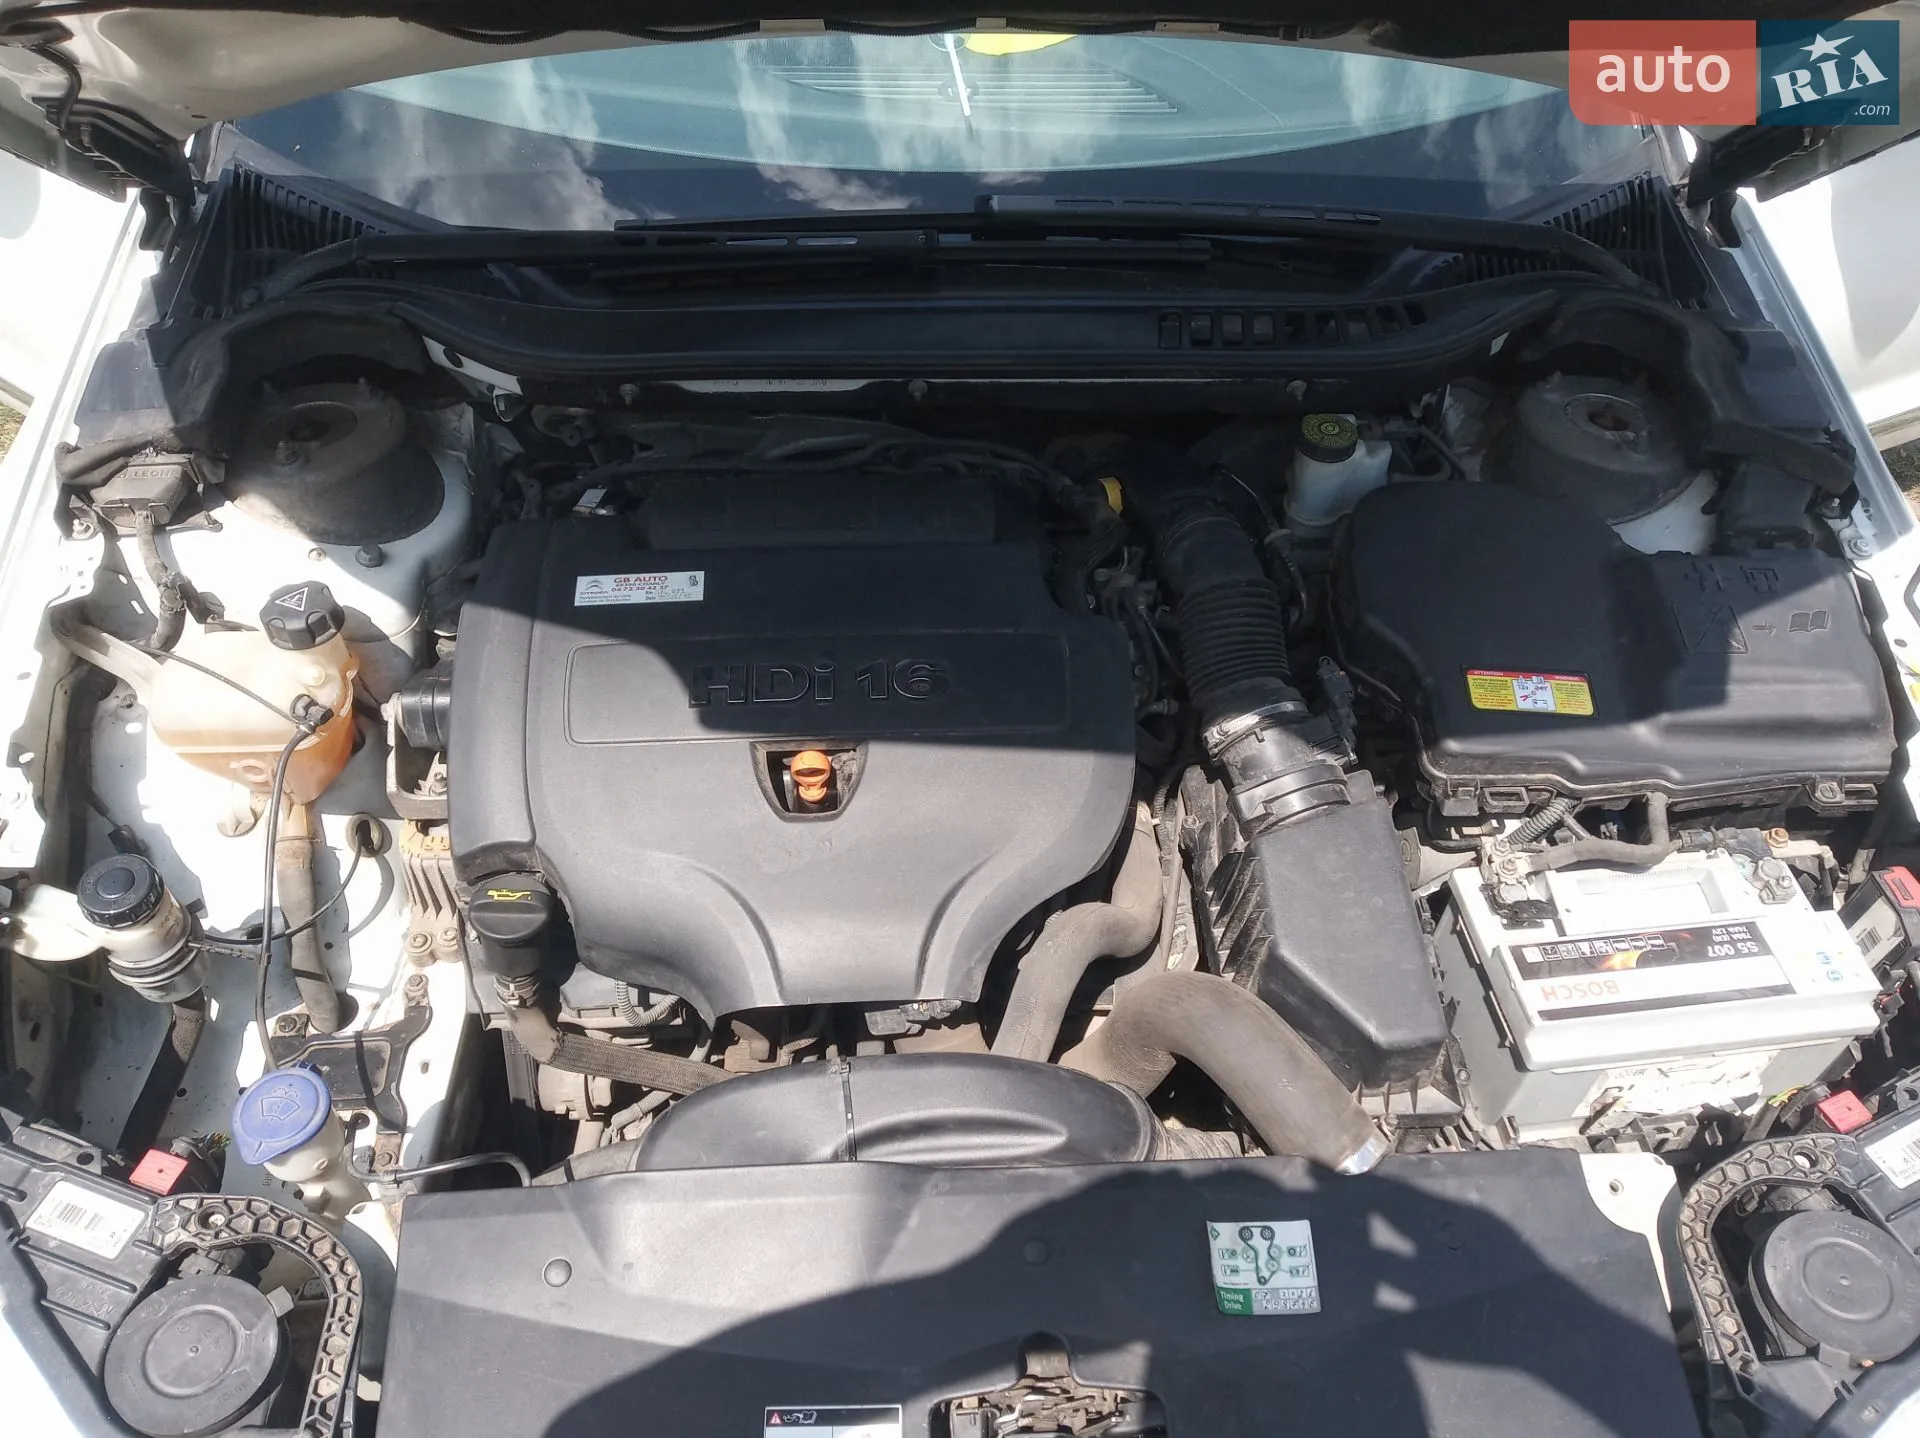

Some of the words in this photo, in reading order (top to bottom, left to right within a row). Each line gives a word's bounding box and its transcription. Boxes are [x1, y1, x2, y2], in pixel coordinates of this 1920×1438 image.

[613, 576, 631, 584] GB
[633, 575, 668, 583] AUTO
[689, 661, 835, 707] HDi
[856, 659, 948, 700] 16
[1707, 944, 1736, 958] 007
[1736, 941, 1759, 954] S5
[1541, 979, 1619, 1002] BOSCH
[1219, 1290, 1245, 1303] Timing
[1223, 1300, 1242, 1311] Drive
